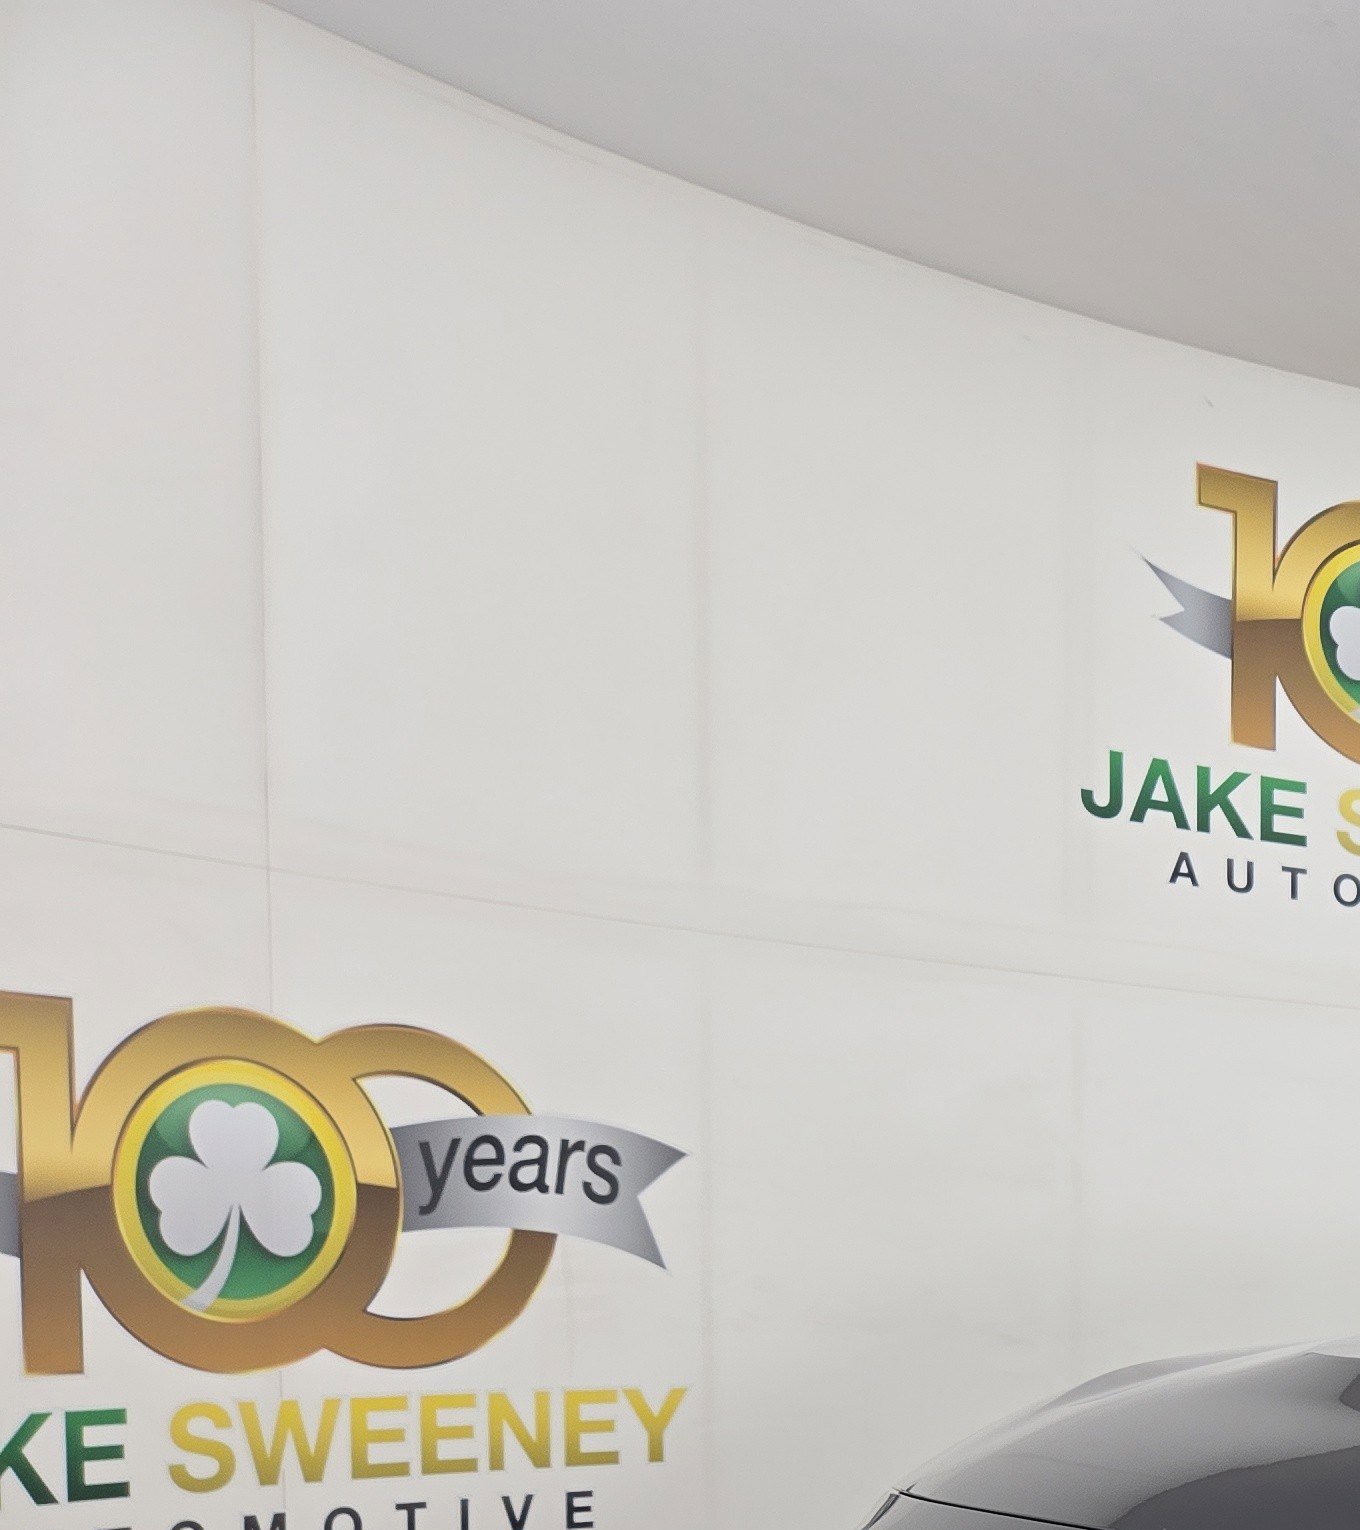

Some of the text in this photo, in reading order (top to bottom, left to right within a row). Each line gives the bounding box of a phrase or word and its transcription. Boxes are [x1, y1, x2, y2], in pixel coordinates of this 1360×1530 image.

[1080, 750, 1308, 847] JAKE
[418, 1132, 623, 1216] years
[168, 1387, 688, 1494] SWEENEY
